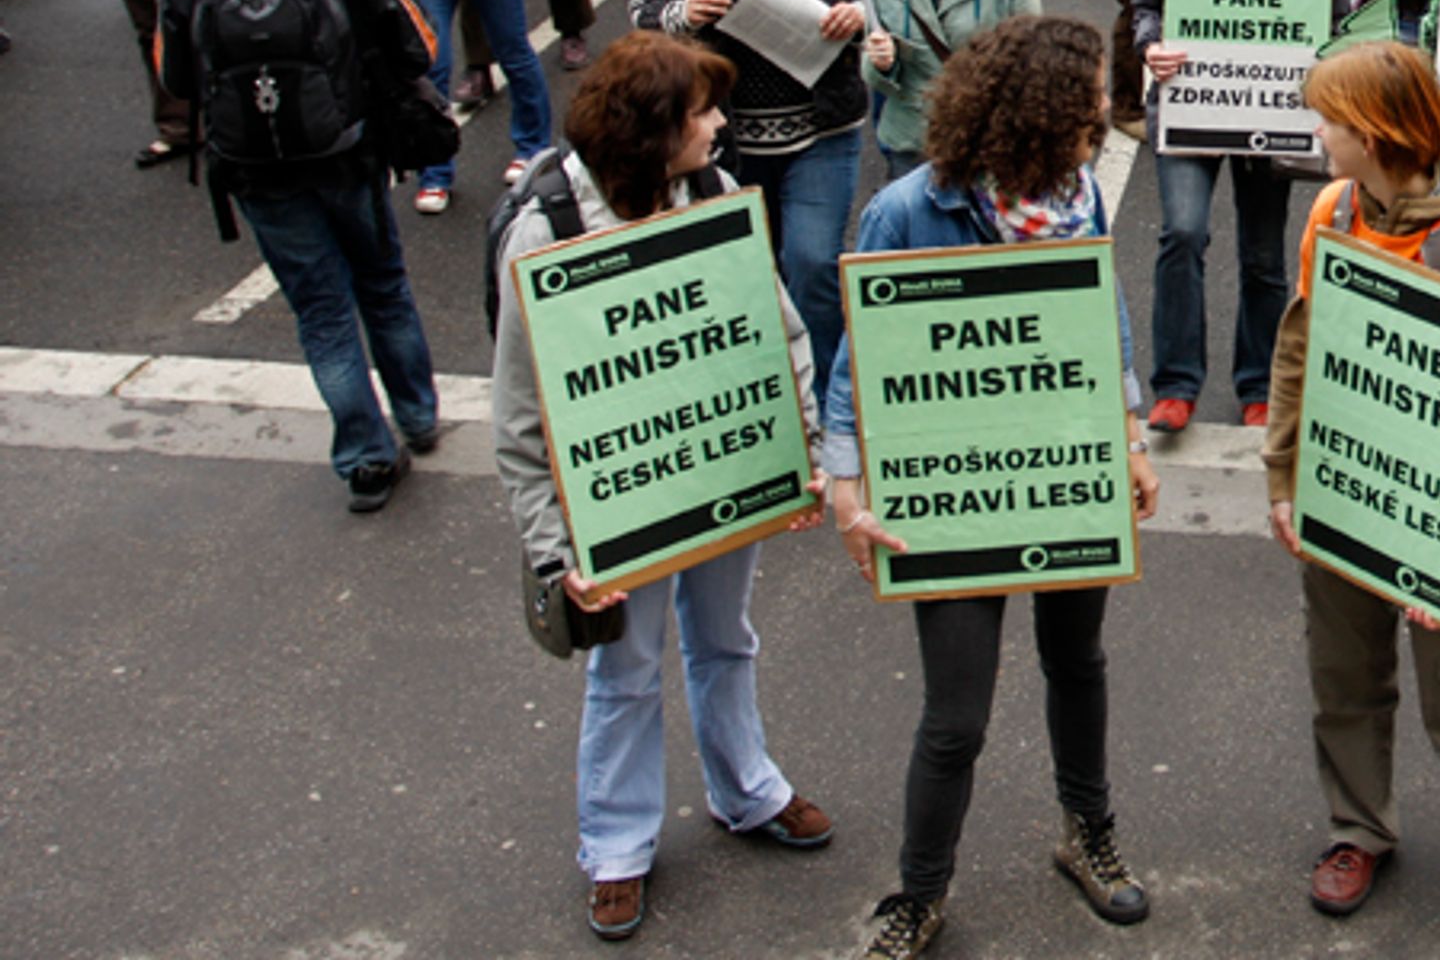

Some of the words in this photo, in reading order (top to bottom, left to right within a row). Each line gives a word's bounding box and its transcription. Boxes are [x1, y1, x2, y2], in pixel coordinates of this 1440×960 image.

[1178, 16, 1314, 45] MINISTŘE,
[1168, 86, 1252, 107] ZDRAVÍ
[604, 279, 708, 337] PANE
[929, 314, 1042, 352] PANE
[564, 315, 762, 401] MINISTŘE,
[883, 353, 1097, 405] MINISTŘE,
[570, 374, 782, 468] NETUNELUJTE
[589, 441, 695, 502] ČESKÉ
[702, 417, 777, 462] LESY
[880, 441, 1112, 480] NEPOŠKOZUJTE
[884, 479, 1016, 521] ZDRAVÍ
[1027, 471, 1115, 509] LESŮ
[1315, 456, 1399, 520] ČESKÉ
